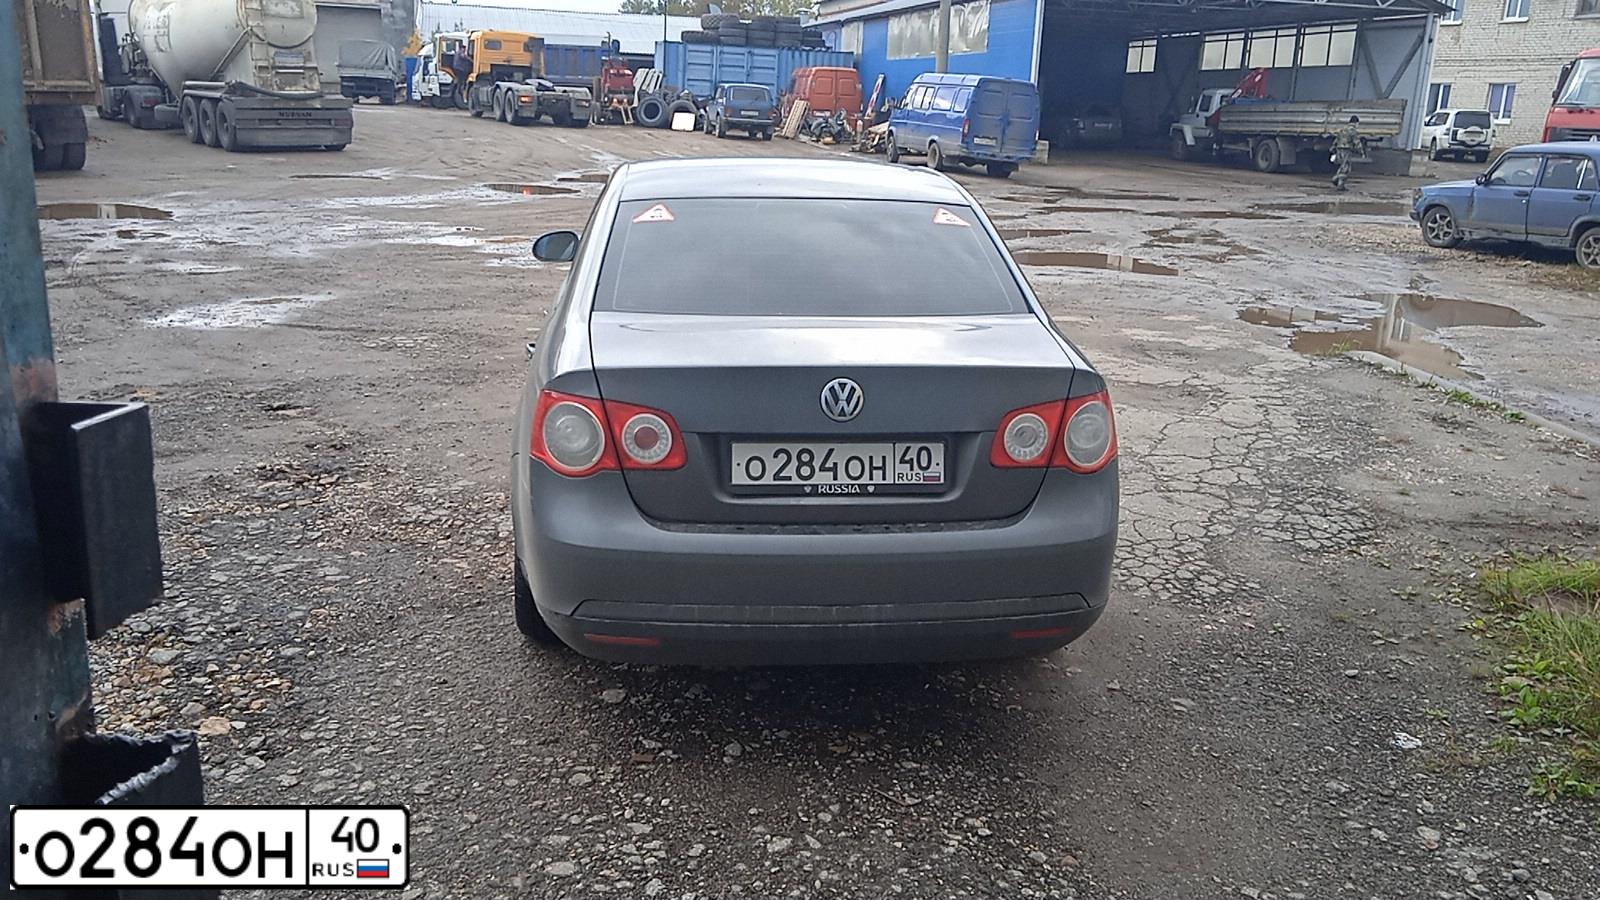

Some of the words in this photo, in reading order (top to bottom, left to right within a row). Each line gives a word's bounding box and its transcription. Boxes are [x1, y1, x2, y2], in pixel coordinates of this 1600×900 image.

[744, 447, 887, 482] O284OH
[898, 445, 933, 472] 40
[897, 472, 922, 482] RUS
[818, 484, 861, 494] RUSSIA
